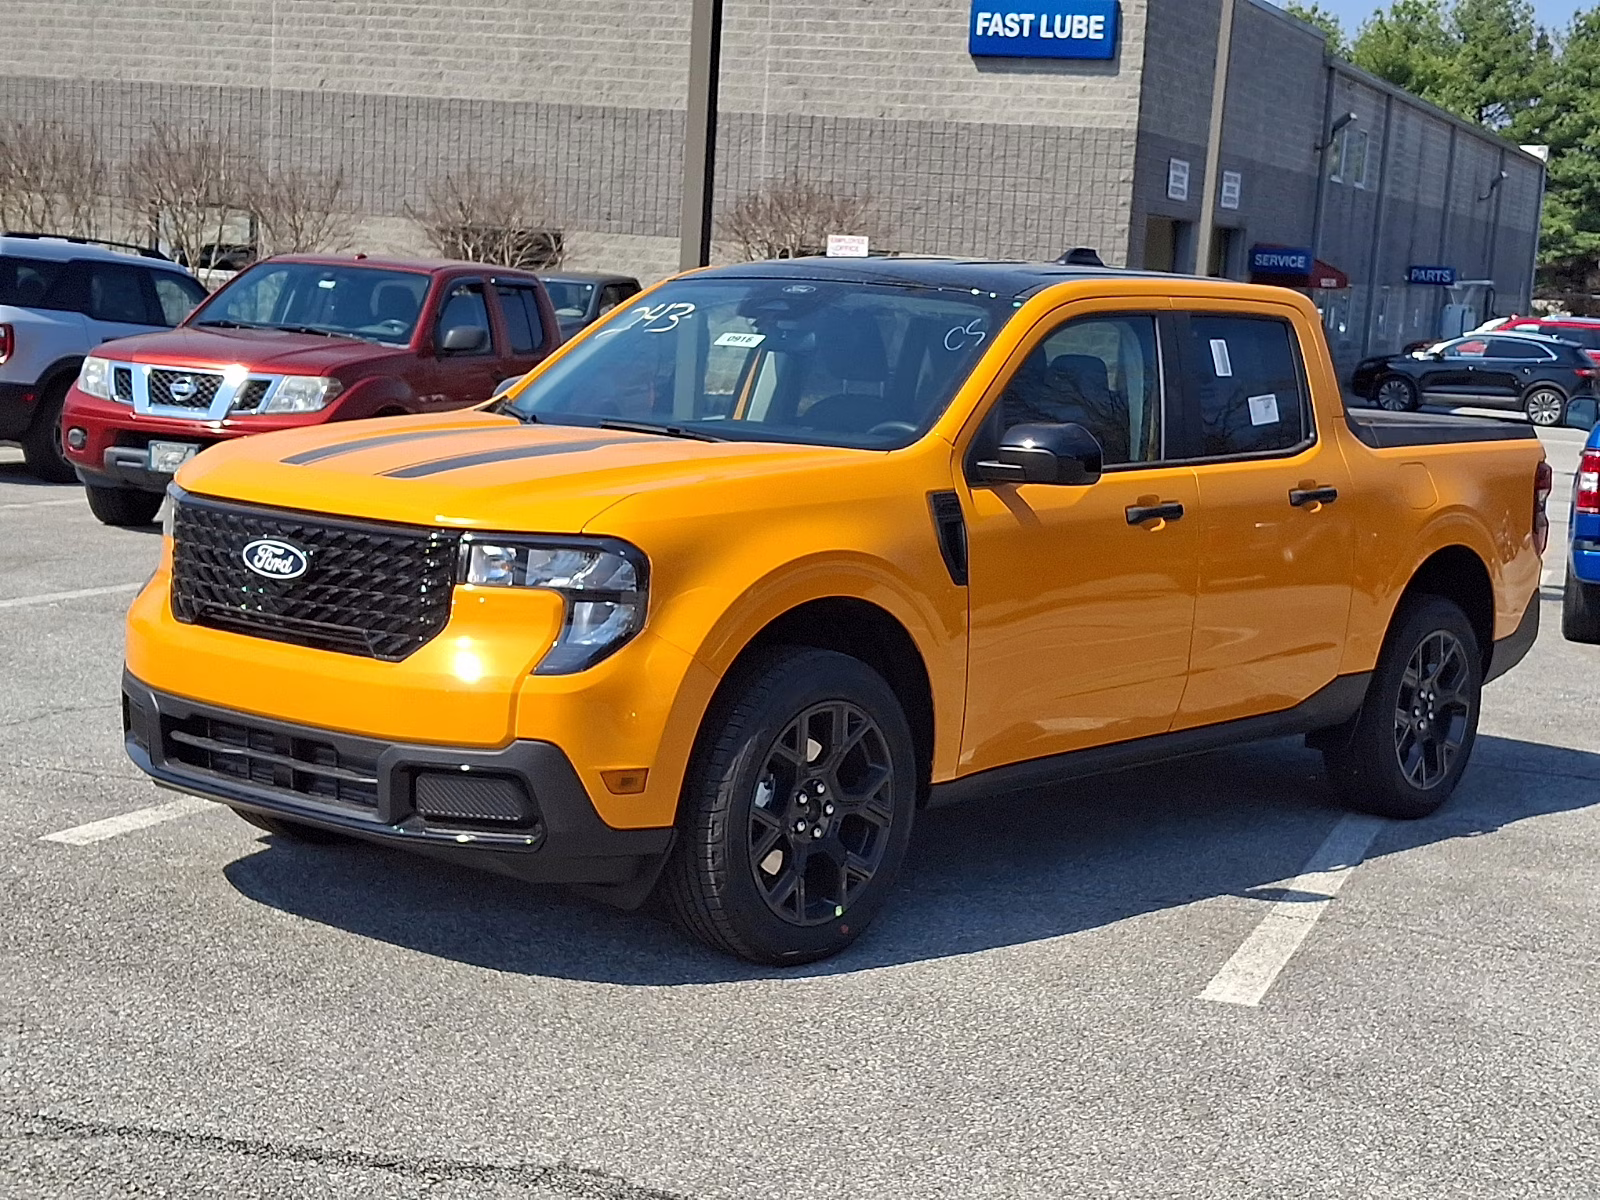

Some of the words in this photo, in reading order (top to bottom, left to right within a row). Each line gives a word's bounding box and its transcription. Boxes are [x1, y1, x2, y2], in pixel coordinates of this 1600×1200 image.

[976, 12, 1035, 37] FAST
[1039, 13, 1105, 39] LUBE
[1254, 254, 1306, 268] SERVICE
[1411, 269, 1451, 282] PARTS
[253, 544, 295, 574] Ford
